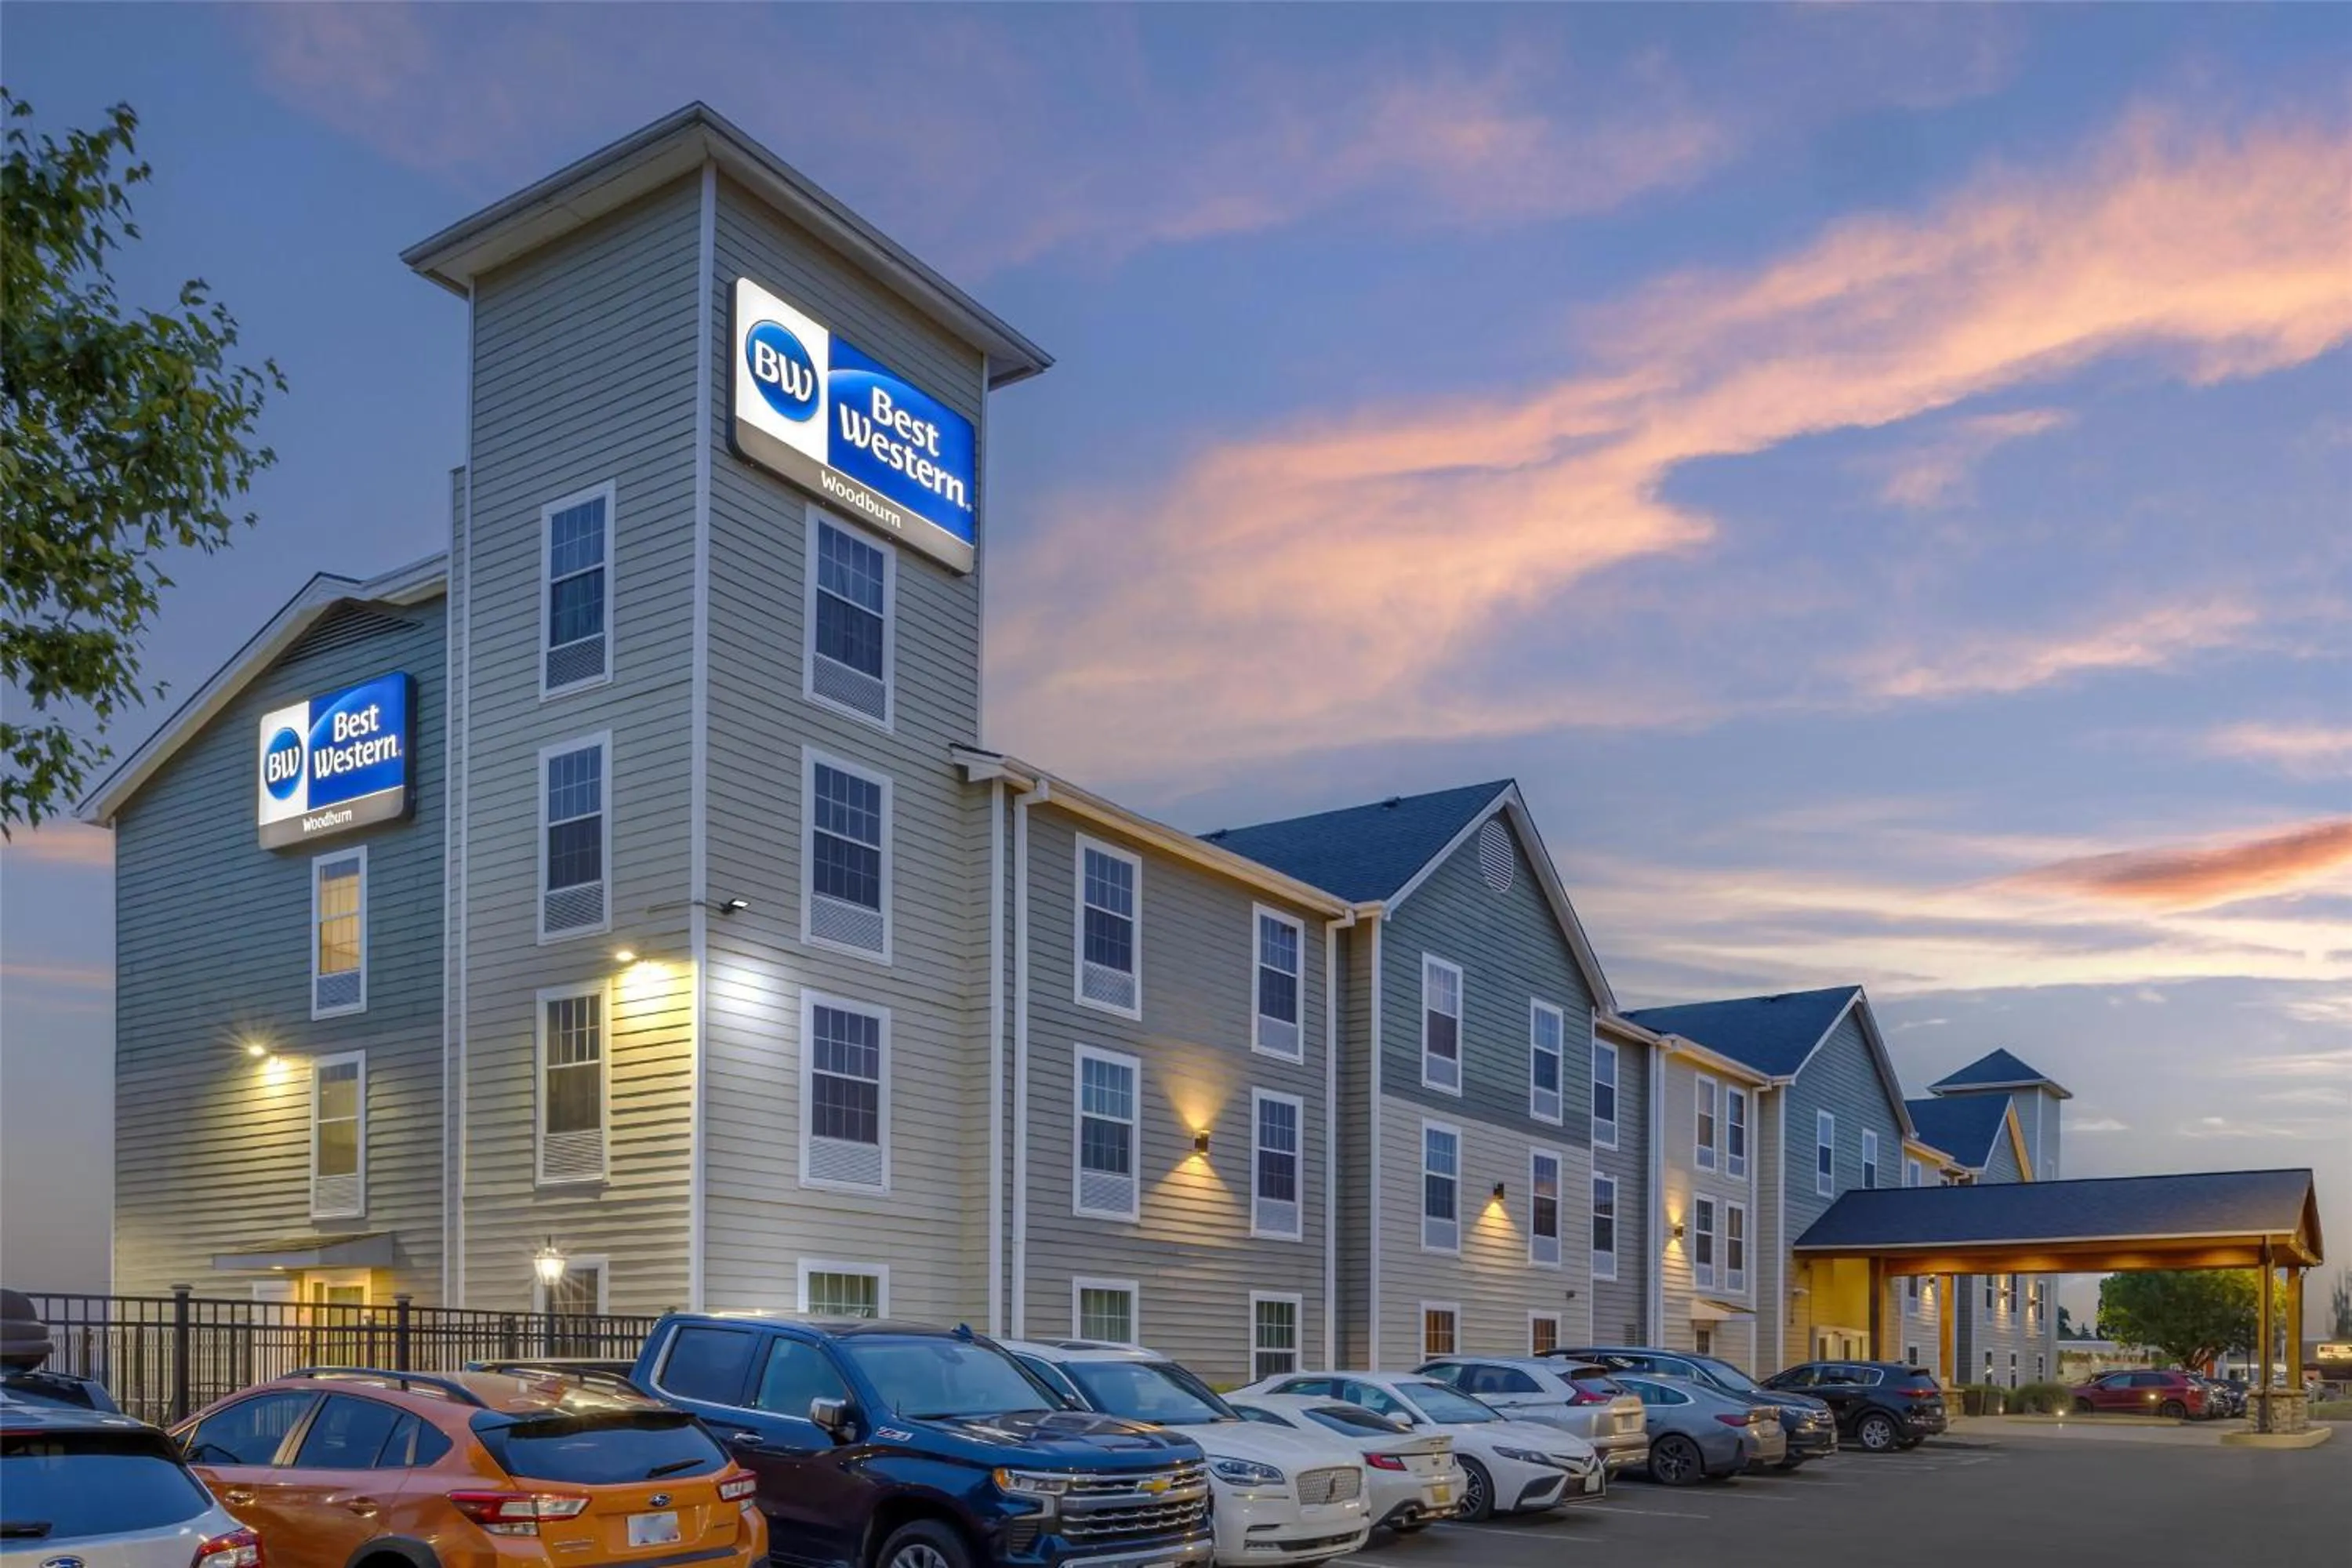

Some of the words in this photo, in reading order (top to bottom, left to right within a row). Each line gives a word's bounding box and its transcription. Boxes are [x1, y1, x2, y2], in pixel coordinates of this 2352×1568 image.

[754, 339, 812, 403] BW
[872, 386, 940, 457] Best
[839, 402, 965, 508] Western
[820, 470, 902, 528] Woodburn
[333, 703, 379, 742] Best
[267, 746, 300, 782] BW
[314, 734, 398, 779] Western
[302, 809, 352, 833] Woodburn
